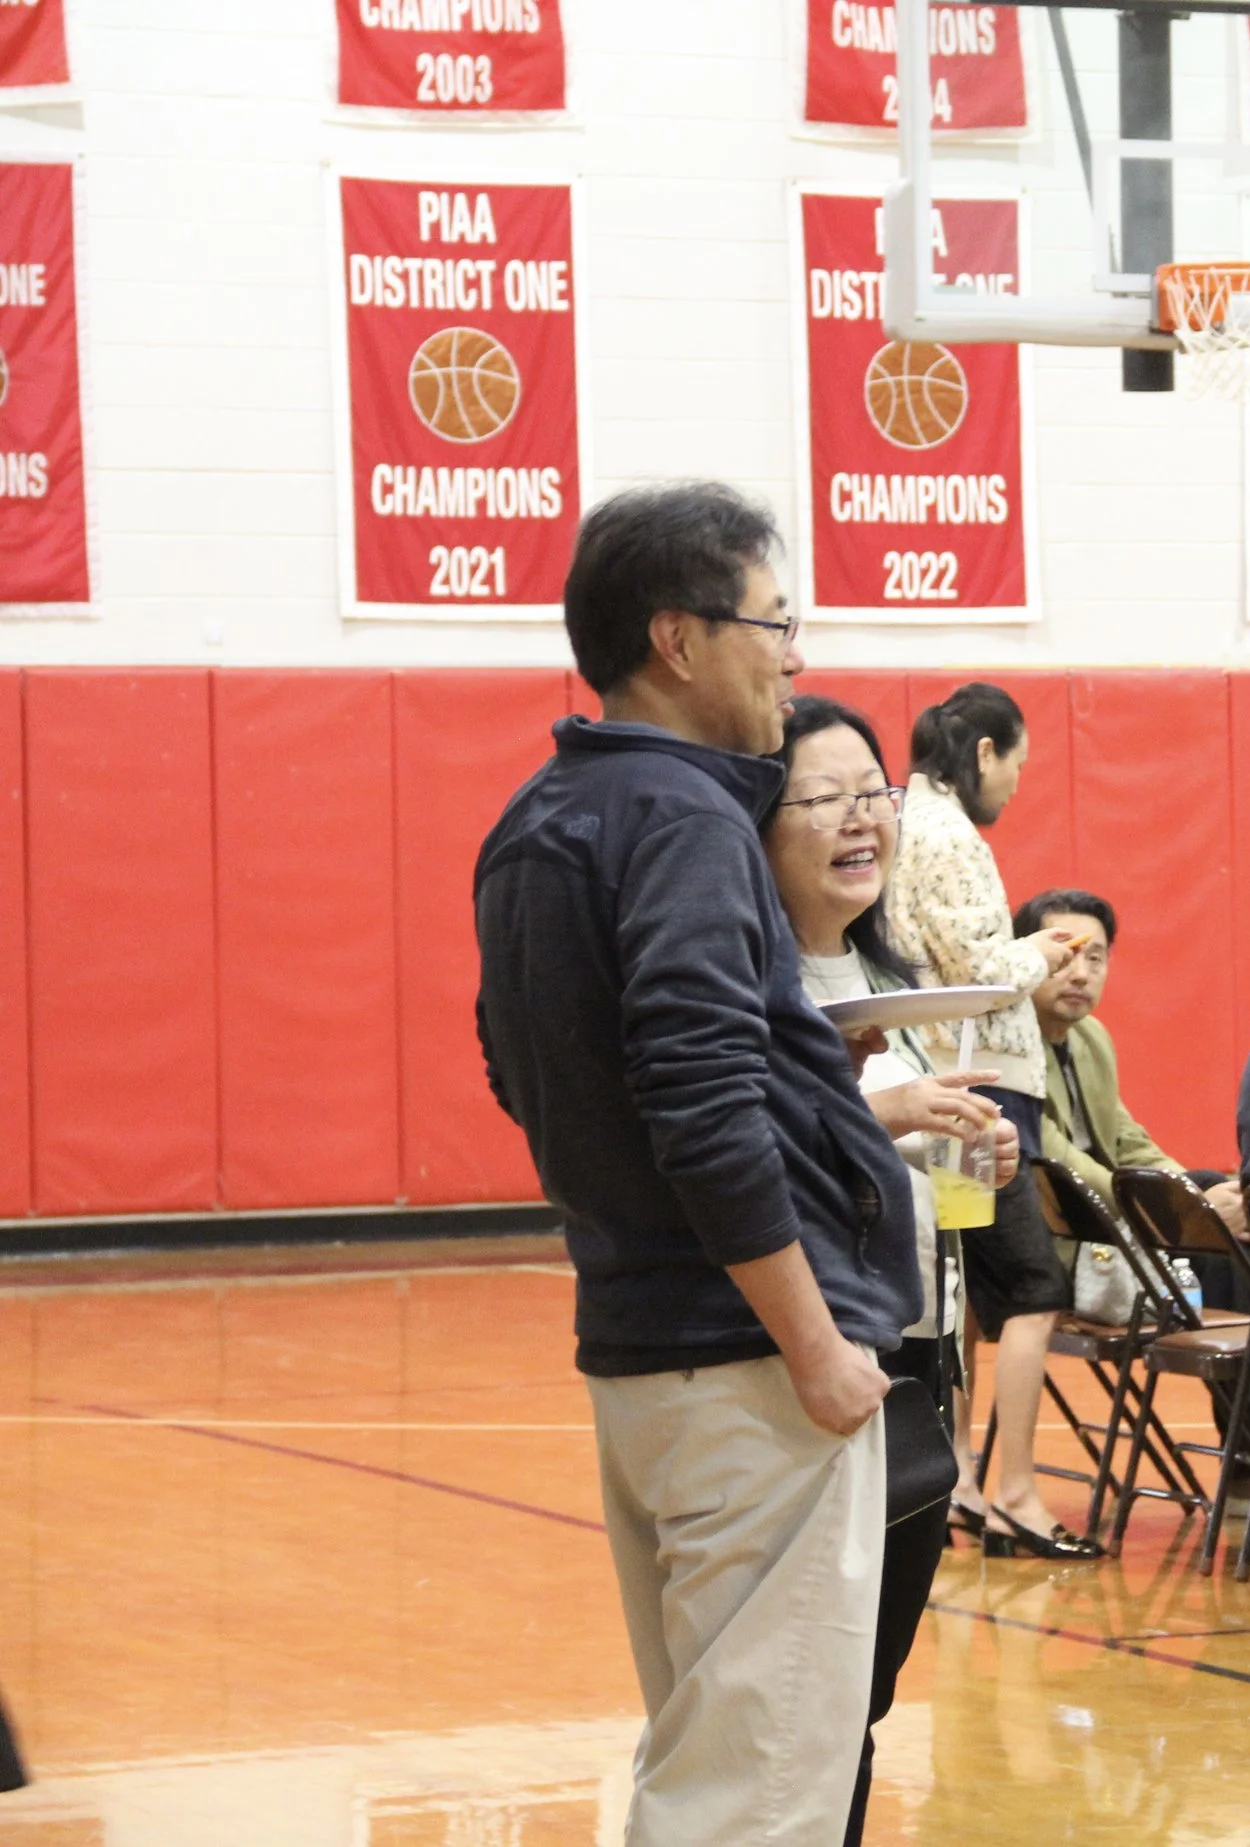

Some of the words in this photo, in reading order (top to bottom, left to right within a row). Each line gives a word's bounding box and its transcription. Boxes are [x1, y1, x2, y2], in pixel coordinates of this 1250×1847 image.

[416, 52, 493, 103] 2003
[882, 74, 952, 122] 24
[418, 191, 497, 243] PIAA
[350, 254, 496, 310] DISTRICT
[504, 259, 569, 312] ONE
[371, 463, 562, 518] CHAMPIONS
[830, 472, 1008, 525] CHAMPIONS
[428, 545, 507, 597] 2021
[883, 550, 959, 600] 2022
